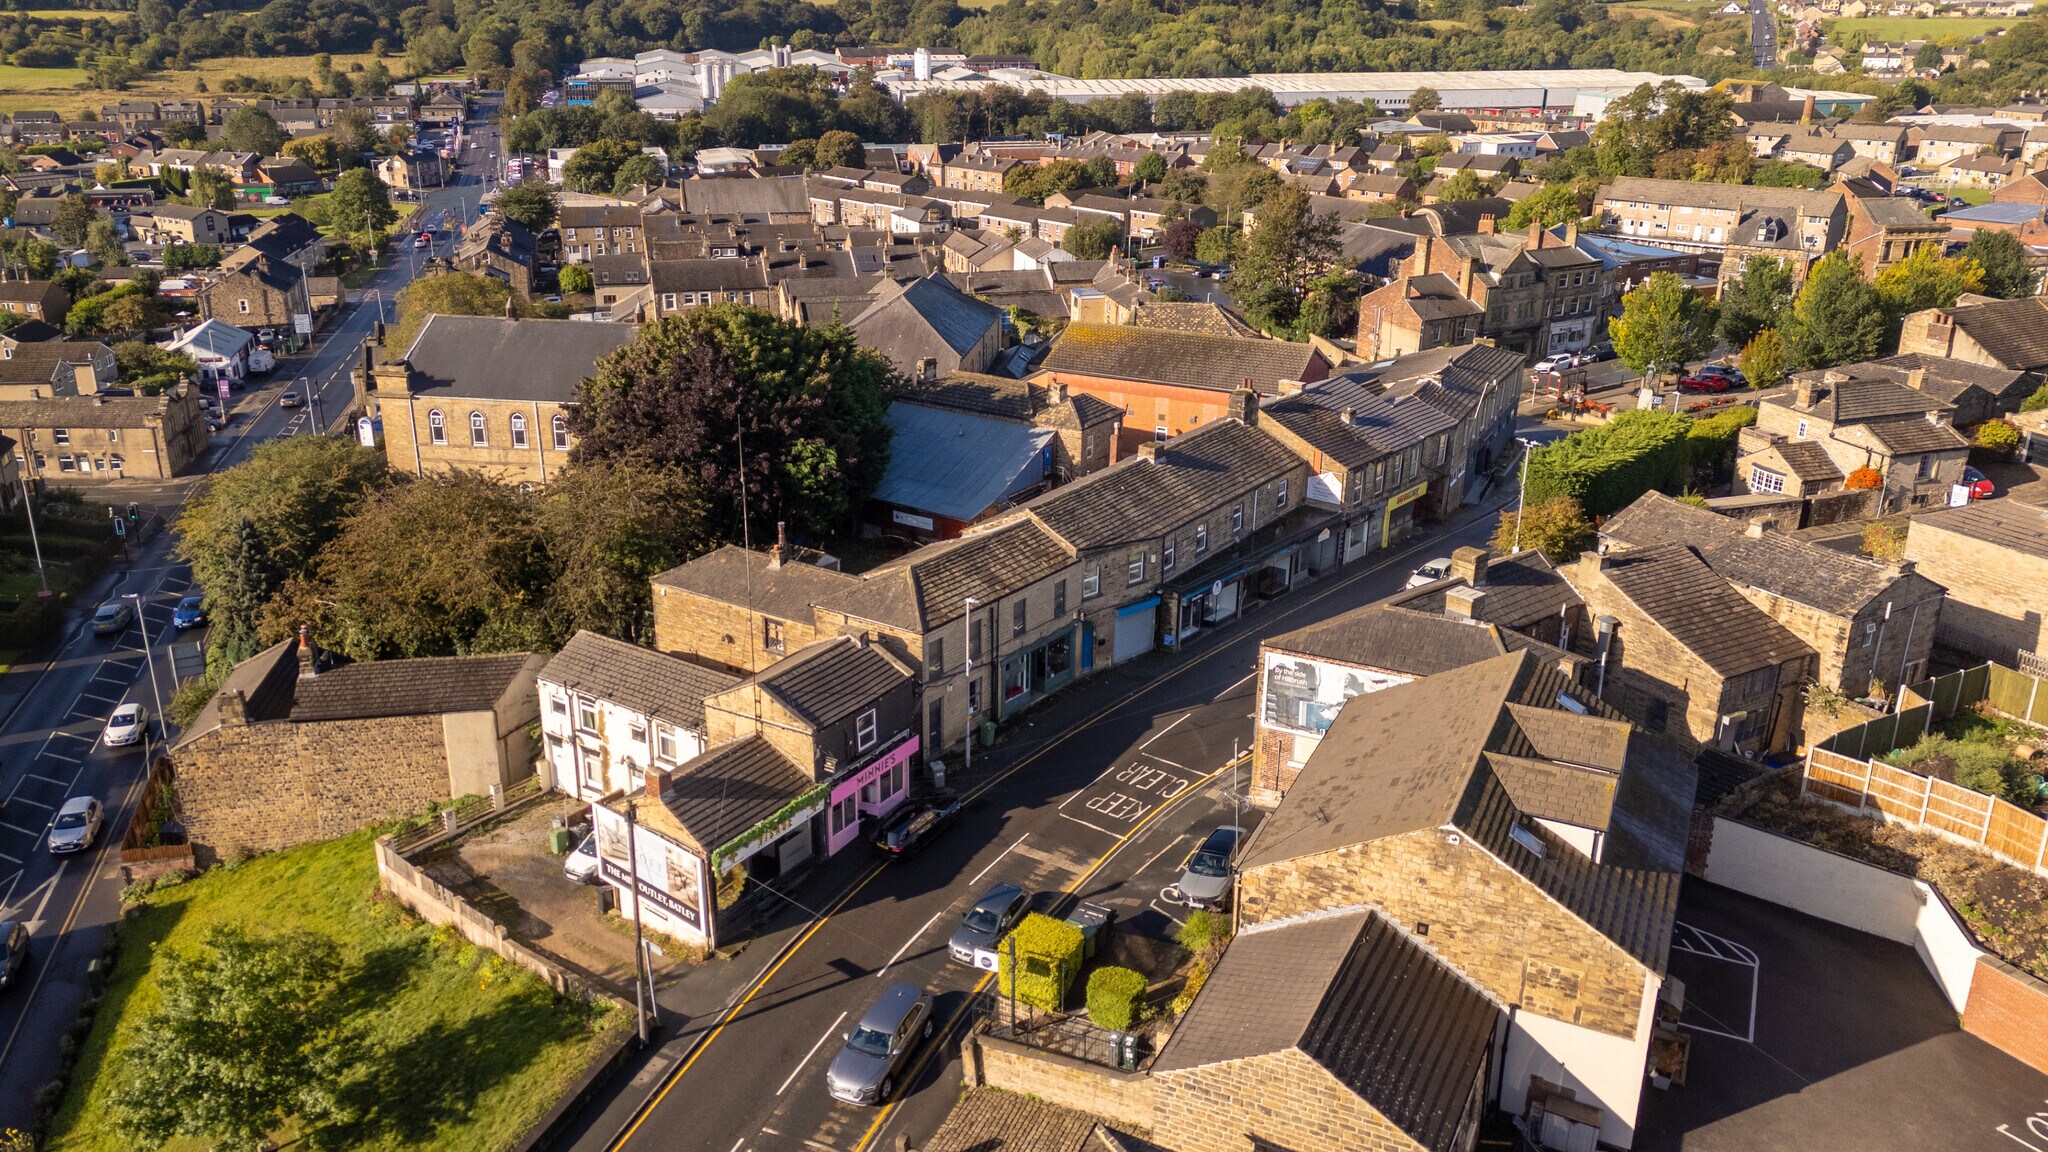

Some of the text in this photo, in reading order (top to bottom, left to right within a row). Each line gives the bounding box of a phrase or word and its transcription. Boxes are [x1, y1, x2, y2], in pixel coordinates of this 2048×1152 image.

[856, 753, 896, 786] MINNIE'S
[1116, 761, 1189, 799] CLEAR
[1086, 791, 1152, 823] KEEP
[605, 863, 621, 879] THE
[669, 899, 696, 921] BATLEY
